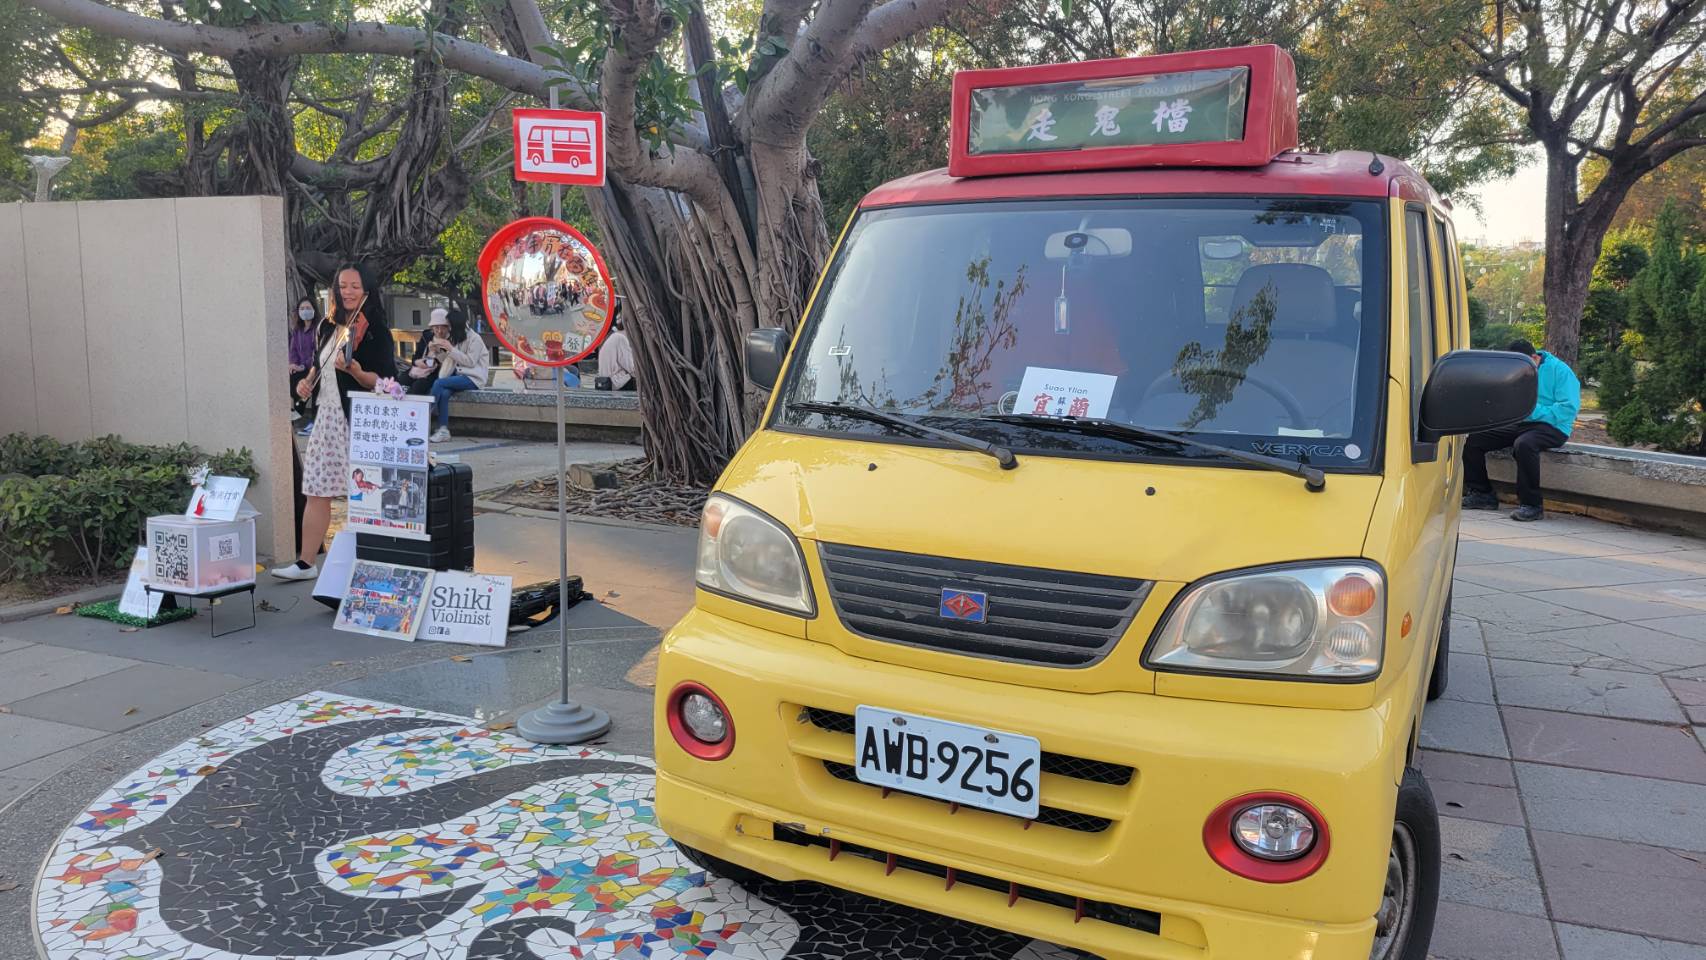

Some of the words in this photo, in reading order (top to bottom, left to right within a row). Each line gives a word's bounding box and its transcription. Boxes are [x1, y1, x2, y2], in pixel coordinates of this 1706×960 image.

[1029, 94, 1057, 105] HONG
[1027, 98, 1193, 142] 走鬼檔
[1043, 383, 1065, 392] Suao
[1251, 442, 1346, 457] VERYCA
[432, 586, 492, 610] Shiki
[432, 608, 491, 625] Violinist
